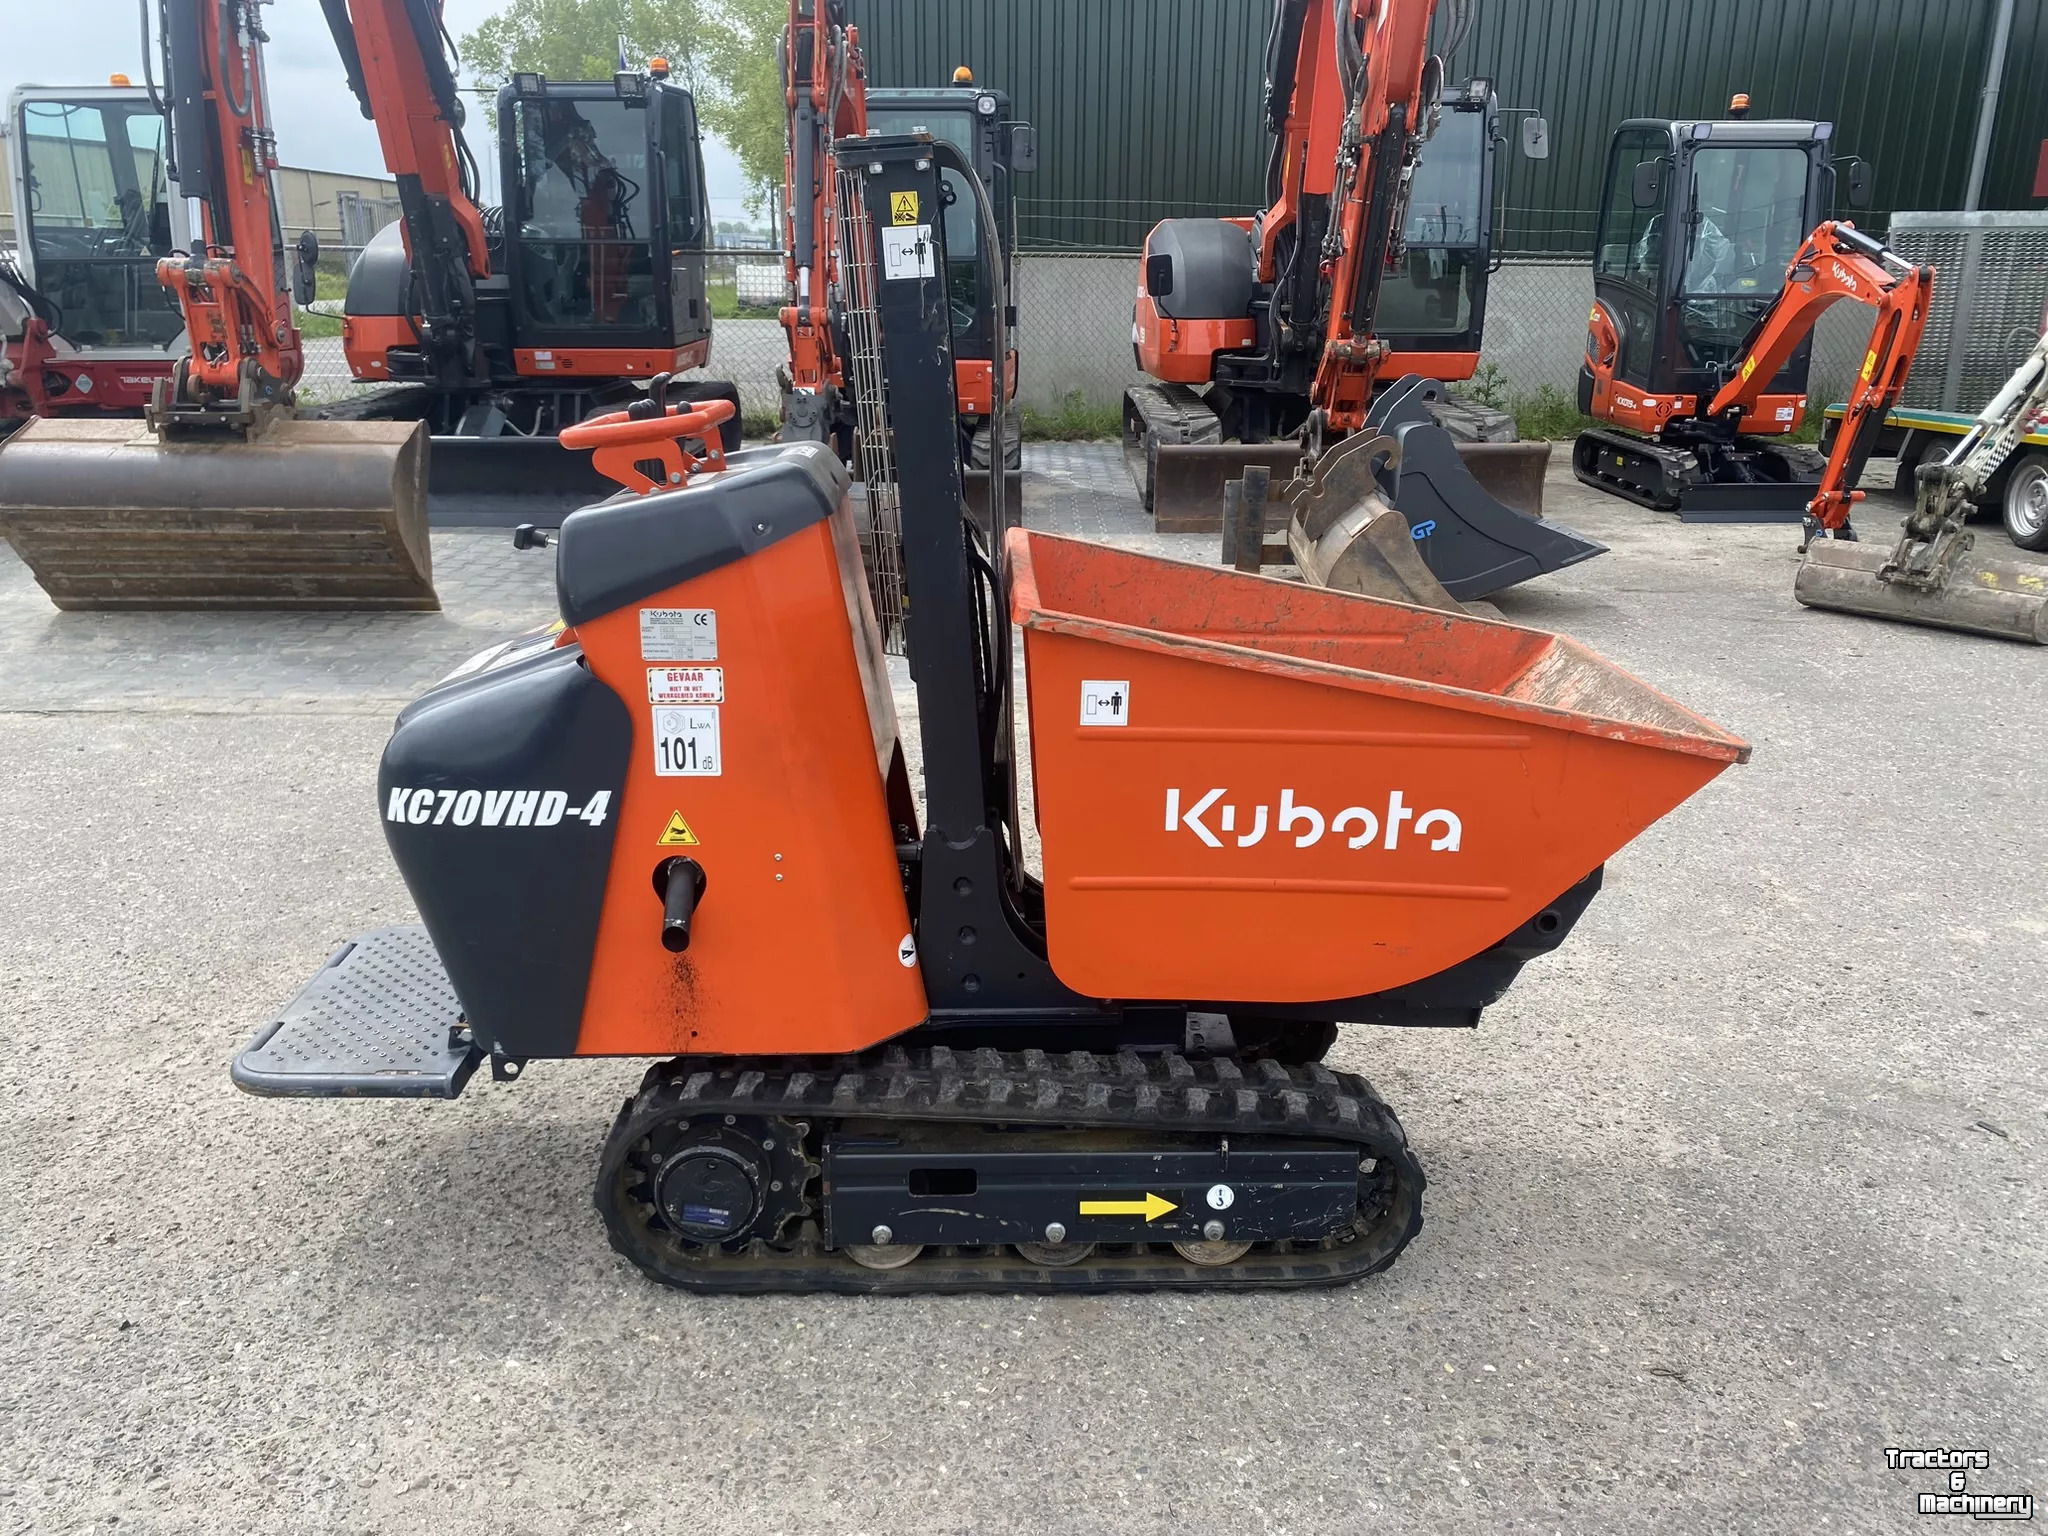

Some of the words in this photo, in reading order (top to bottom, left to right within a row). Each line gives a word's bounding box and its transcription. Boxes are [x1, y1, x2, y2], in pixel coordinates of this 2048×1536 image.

[1832, 261, 1857, 292] Kubota
[650, 610, 682, 618] Kubota
[667, 672, 704, 682] GEVAAR
[660, 737, 697, 770] 101
[703, 756, 713, 770] dB
[387, 787, 612, 827] KC70VHD-4
[1165, 788, 1462, 852] Kubota
